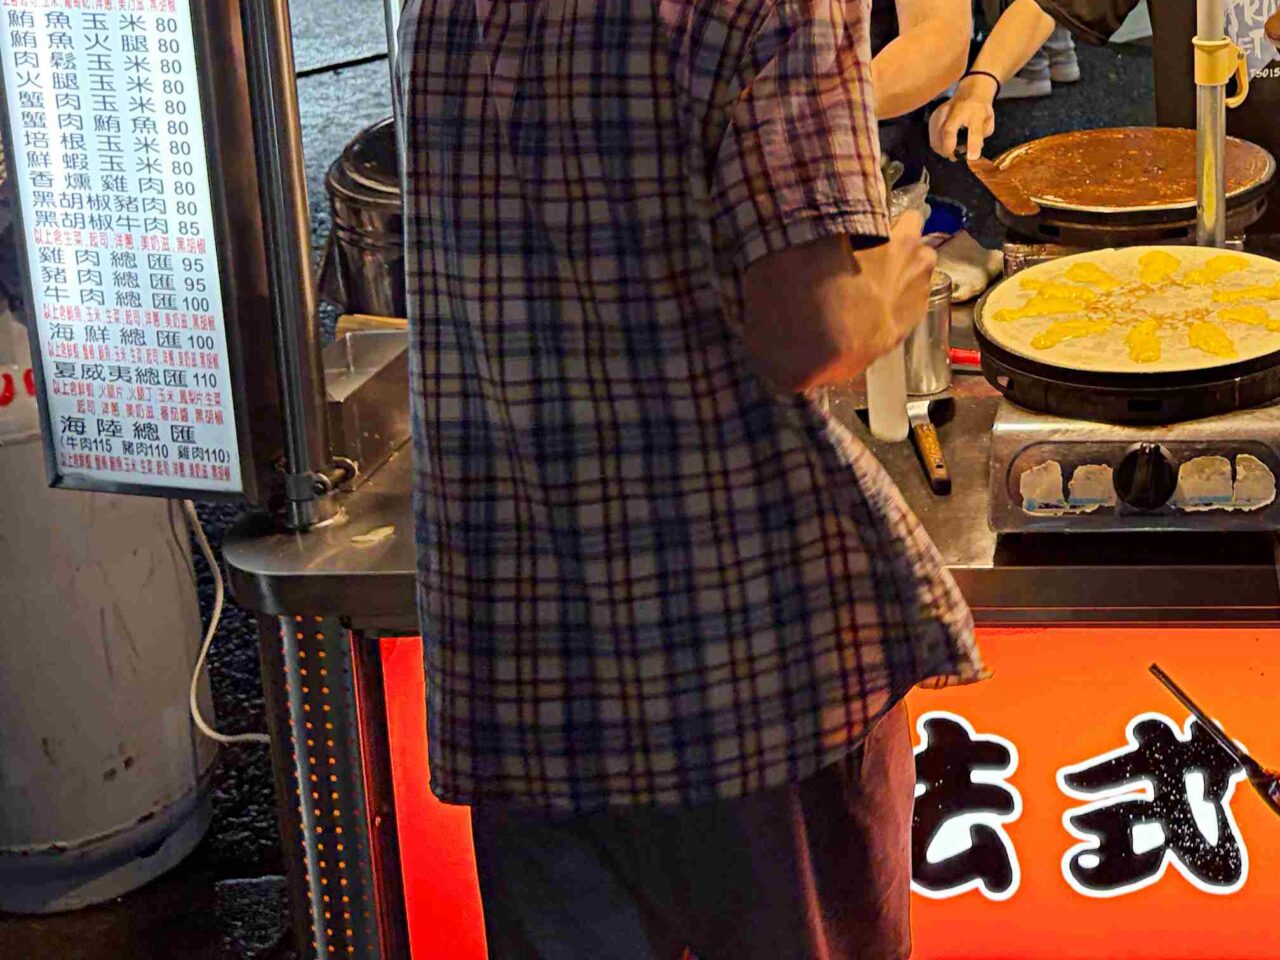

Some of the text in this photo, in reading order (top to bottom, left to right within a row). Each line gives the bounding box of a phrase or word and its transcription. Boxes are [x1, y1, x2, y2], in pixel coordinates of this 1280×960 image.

[8, 10, 177, 32] 鮪魚玉米 80
[10, 31, 179, 53] 鮪魚火腿 80
[160, 59, 181, 74] 80
[16, 72, 184, 94] 火腿玉米 80
[165, 100, 186, 114] 80
[167, 120, 188, 135] 80
[23, 131, 191, 155] 培根玉米 80
[27, 151, 193, 176] 鮮蝦玉米 80
[174, 181, 195, 195] 80
[32, 191, 197, 215] 黑胡椒豬肉 80
[34, 211, 200, 235] 黑胡椒牛肉 85
[39, 247, 204, 272] 雞肉總匯 95
[41, 267, 206, 292] 豬肉總匯 95
[44, 286, 210, 312] 牛肉總匯 100
[49, 323, 214, 350] 海鮮總匯 100
[53, 362, 217, 388] 夏威夷總匯 110
[60, 415, 196, 443] 海陸總匯
